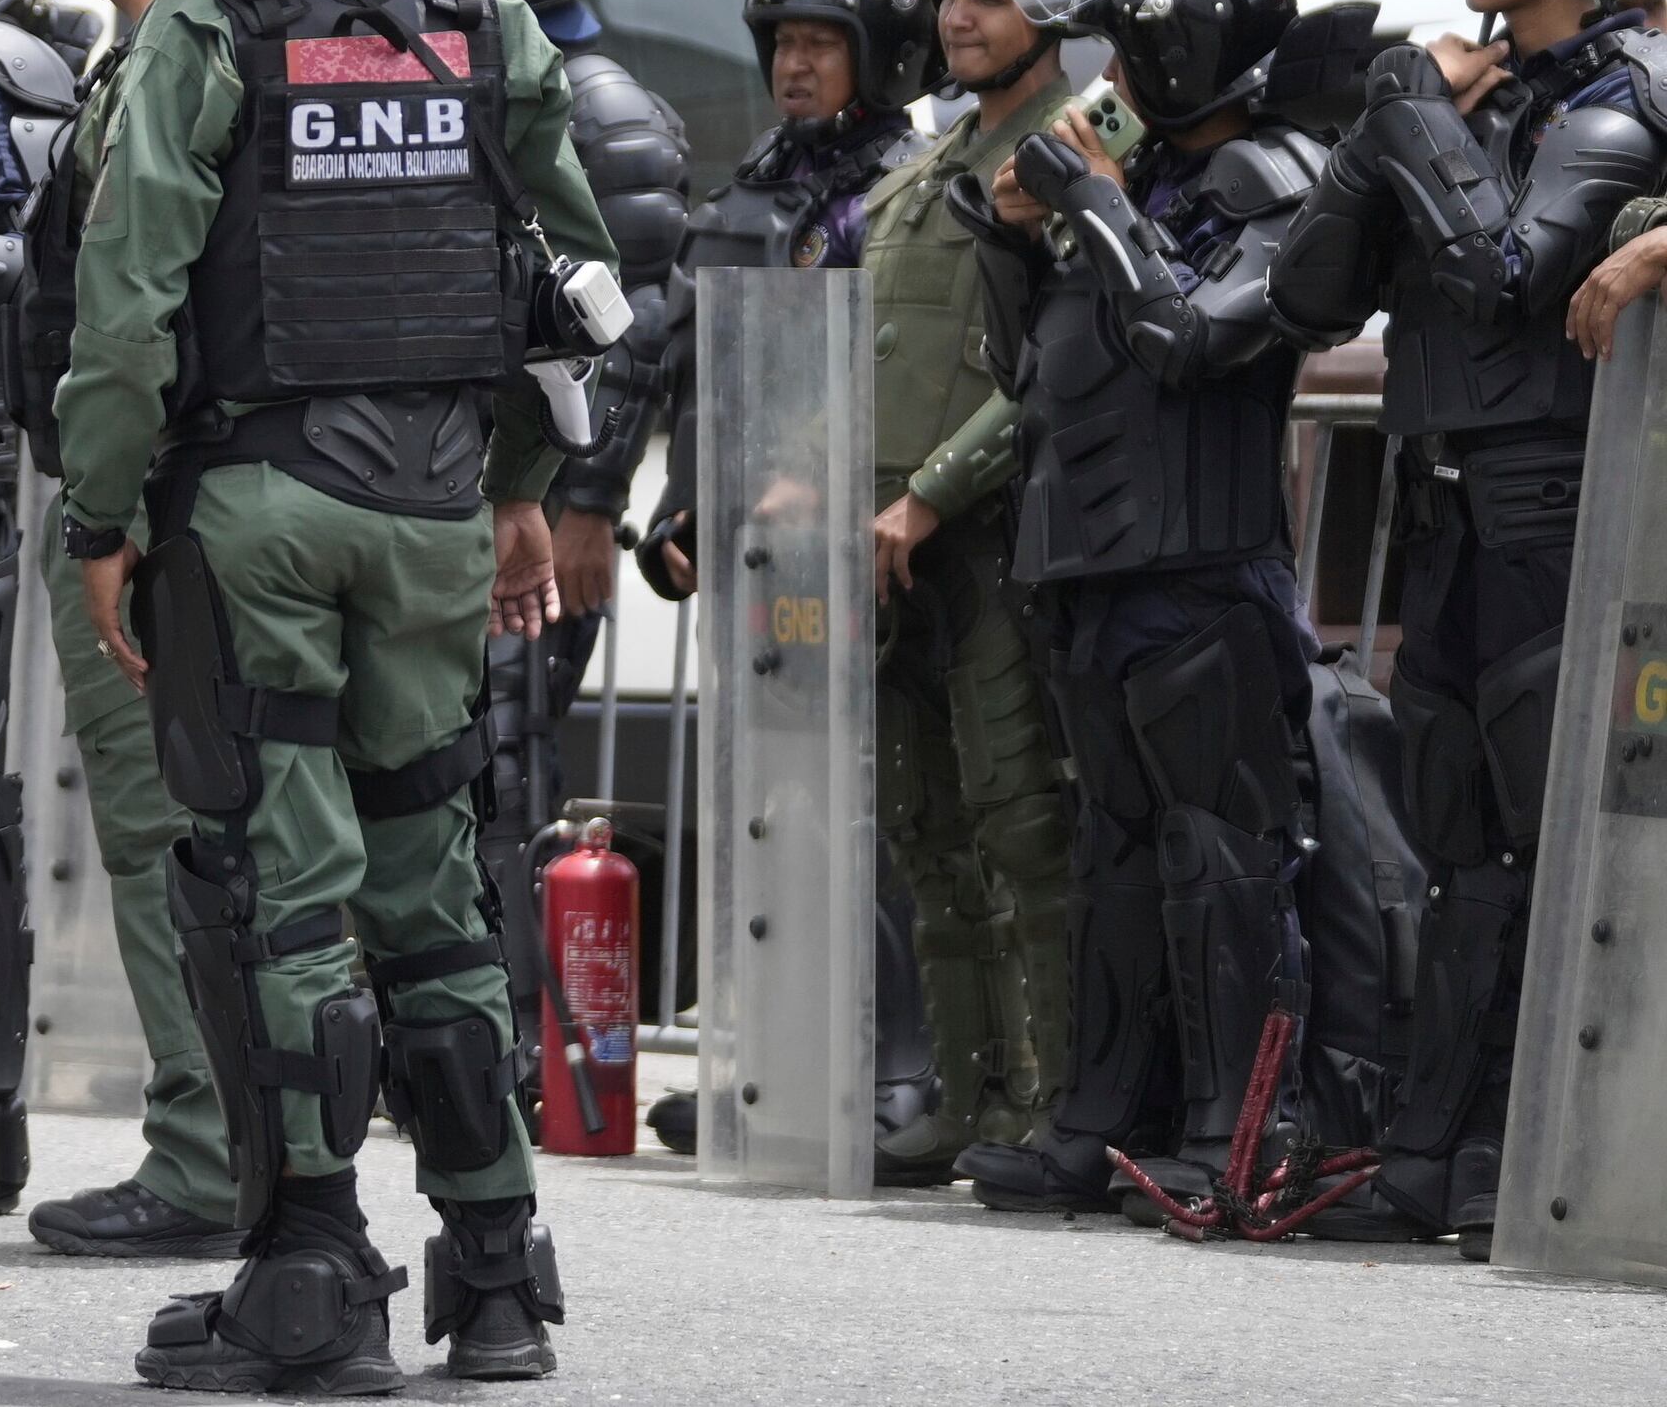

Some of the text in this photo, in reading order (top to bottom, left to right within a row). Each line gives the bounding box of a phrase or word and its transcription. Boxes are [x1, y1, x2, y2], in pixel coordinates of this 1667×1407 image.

[291, 98, 465, 149] G.N.B
[293, 147, 470, 180] GUARDIA NACIONAL BOLIVARIANA
[773, 594, 826, 644] GNB
